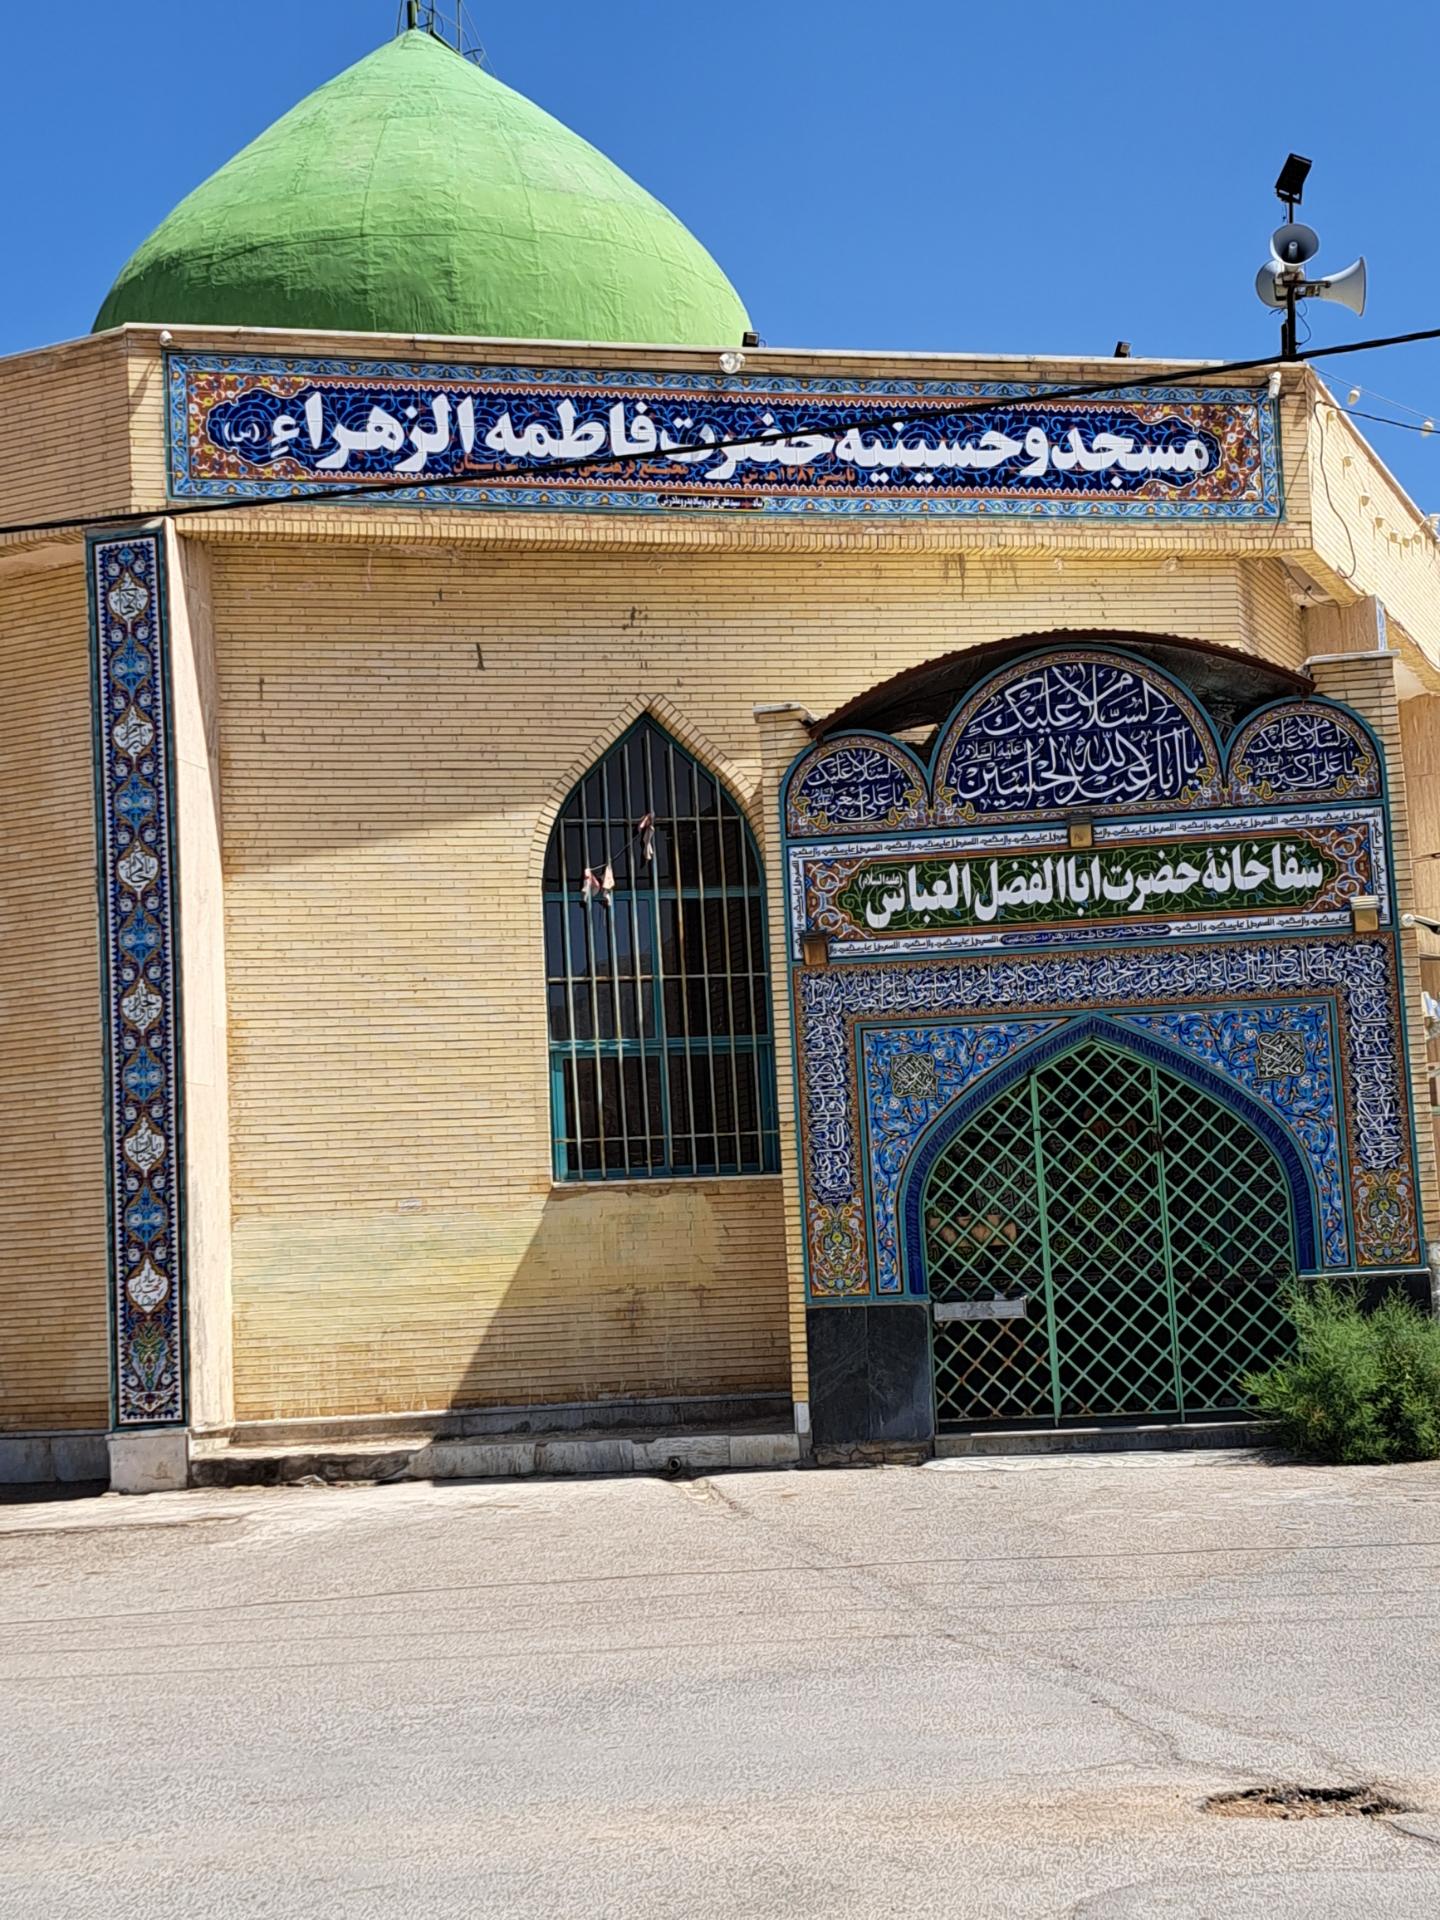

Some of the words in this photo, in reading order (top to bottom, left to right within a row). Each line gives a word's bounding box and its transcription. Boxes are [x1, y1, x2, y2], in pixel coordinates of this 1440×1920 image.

[485, 398, 658, 460] فاطمه
[660, 412, 836, 481] حضرت
[1019, 427, 1050, 477] و
[1053, 411, 1209, 488] مسجد
[866, 861, 972, 929] العباس
[1103, 850, 1202, 912] حضرت
